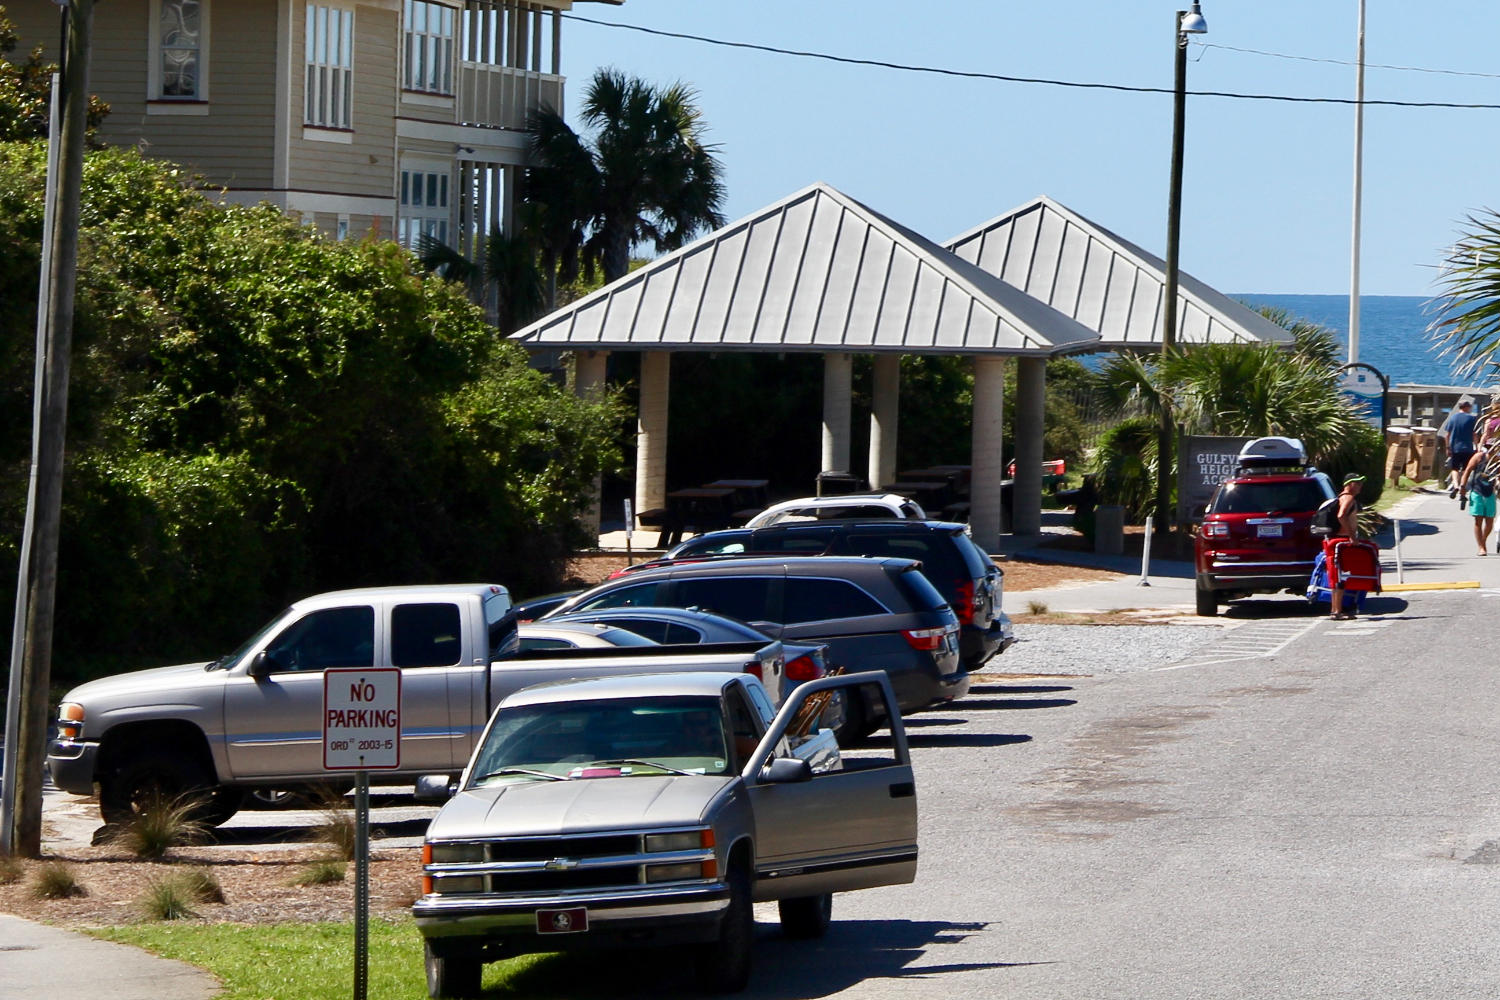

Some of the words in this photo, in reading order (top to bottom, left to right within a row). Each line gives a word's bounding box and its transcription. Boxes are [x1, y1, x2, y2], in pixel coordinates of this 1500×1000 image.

[350, 683, 375, 702] NO
[327, 709, 397, 728] PARKING
[358, 739, 393, 750] 2003-15
